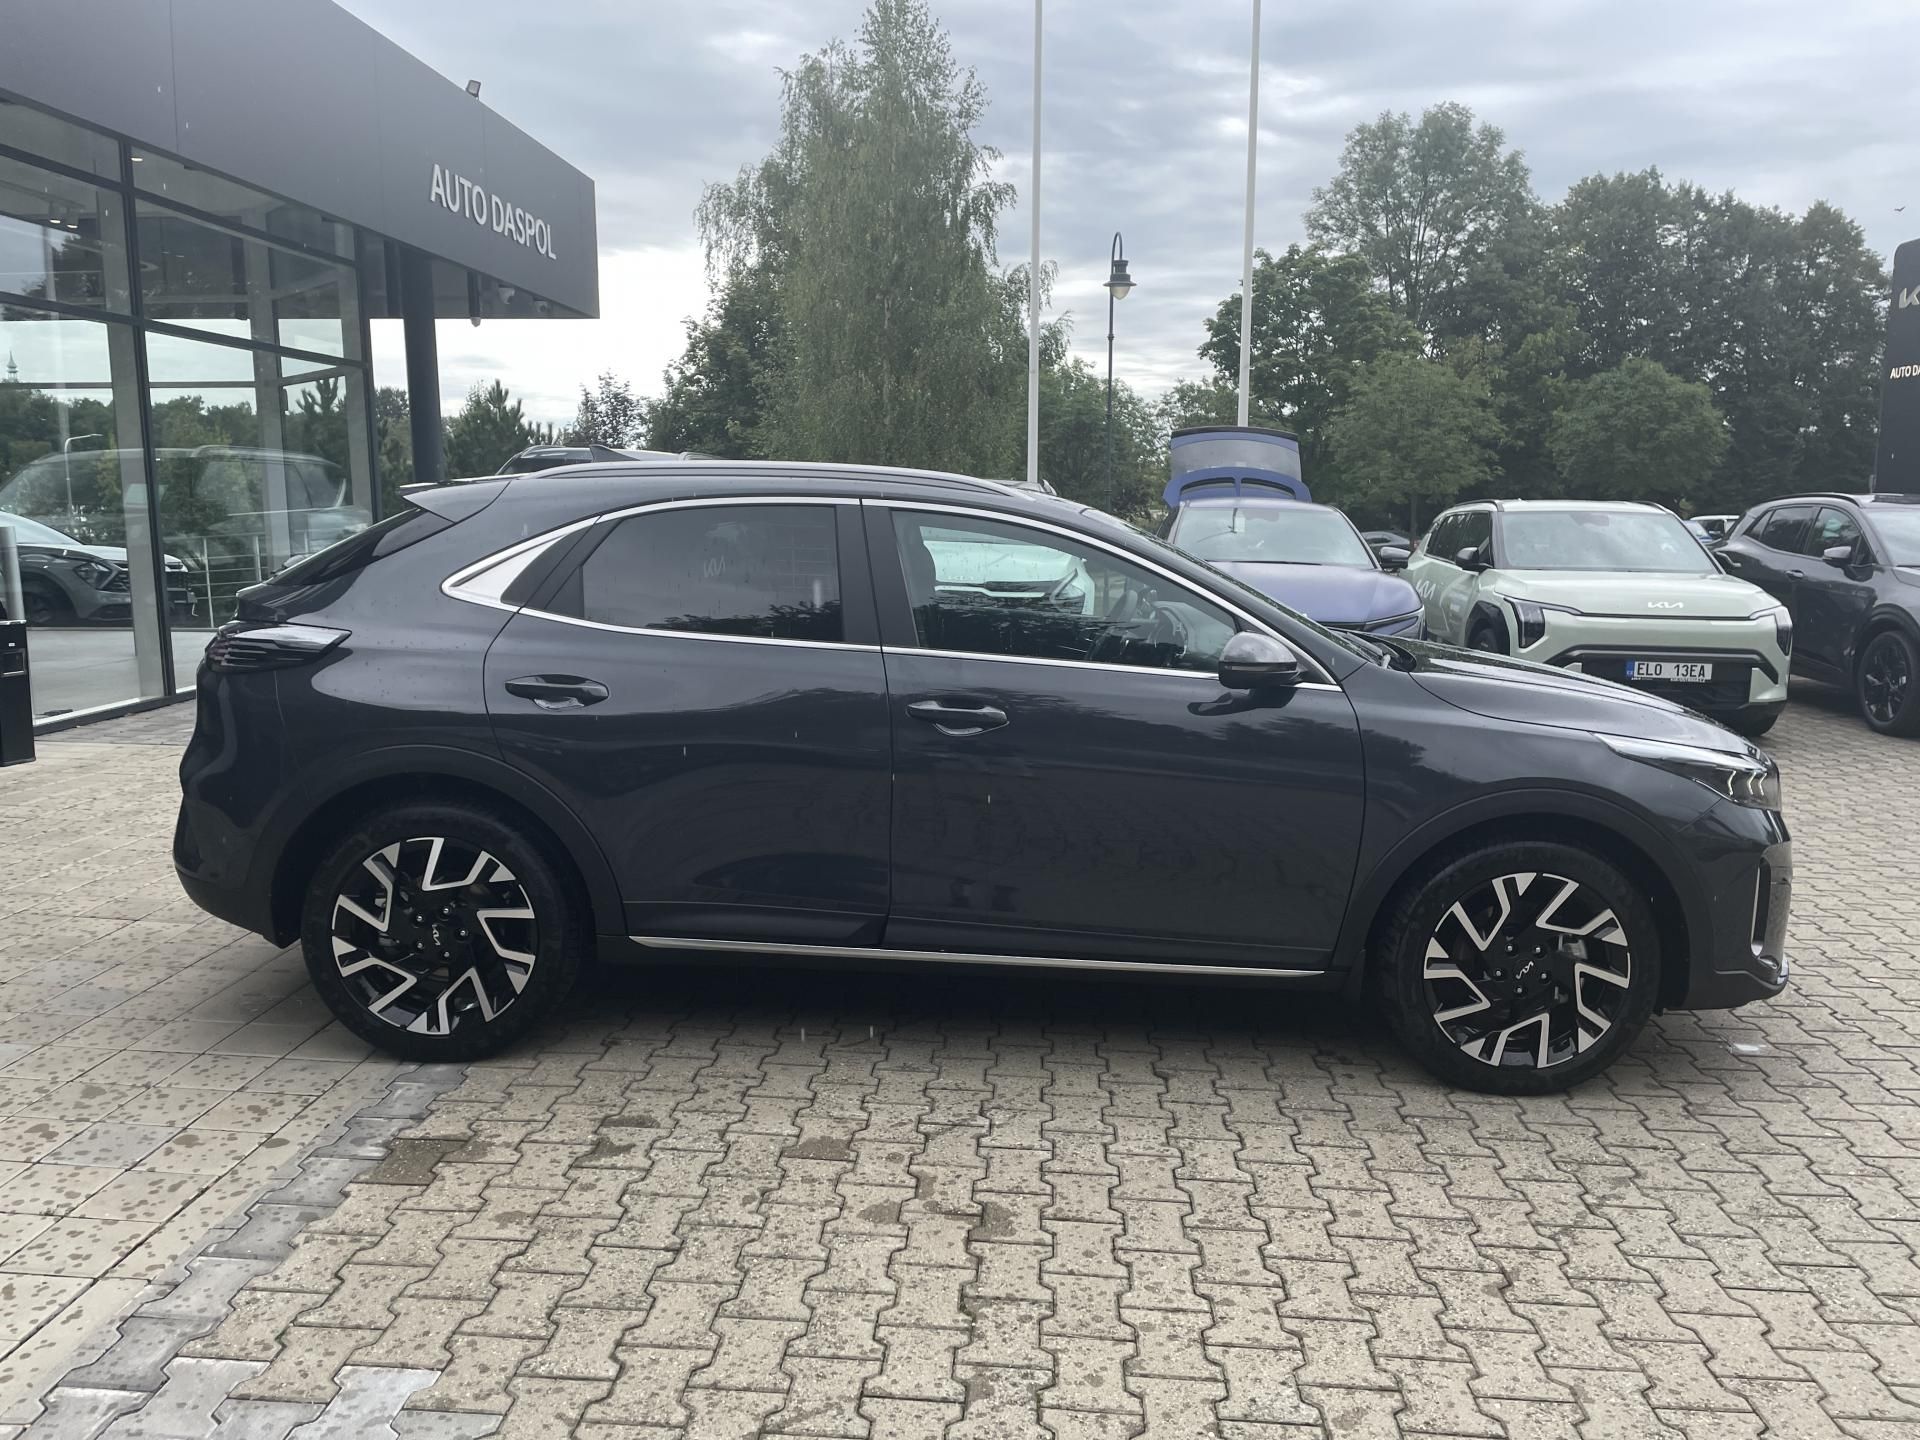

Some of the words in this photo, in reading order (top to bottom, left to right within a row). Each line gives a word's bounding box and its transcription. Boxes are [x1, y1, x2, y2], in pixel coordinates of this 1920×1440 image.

[431, 163, 488, 225] AUTO
[491, 193, 557, 260] DASPOL
[1889, 365, 1912, 379] AUTO
[1647, 601, 1684, 609] KIA
[1673, 664, 1705, 678] 13EA
